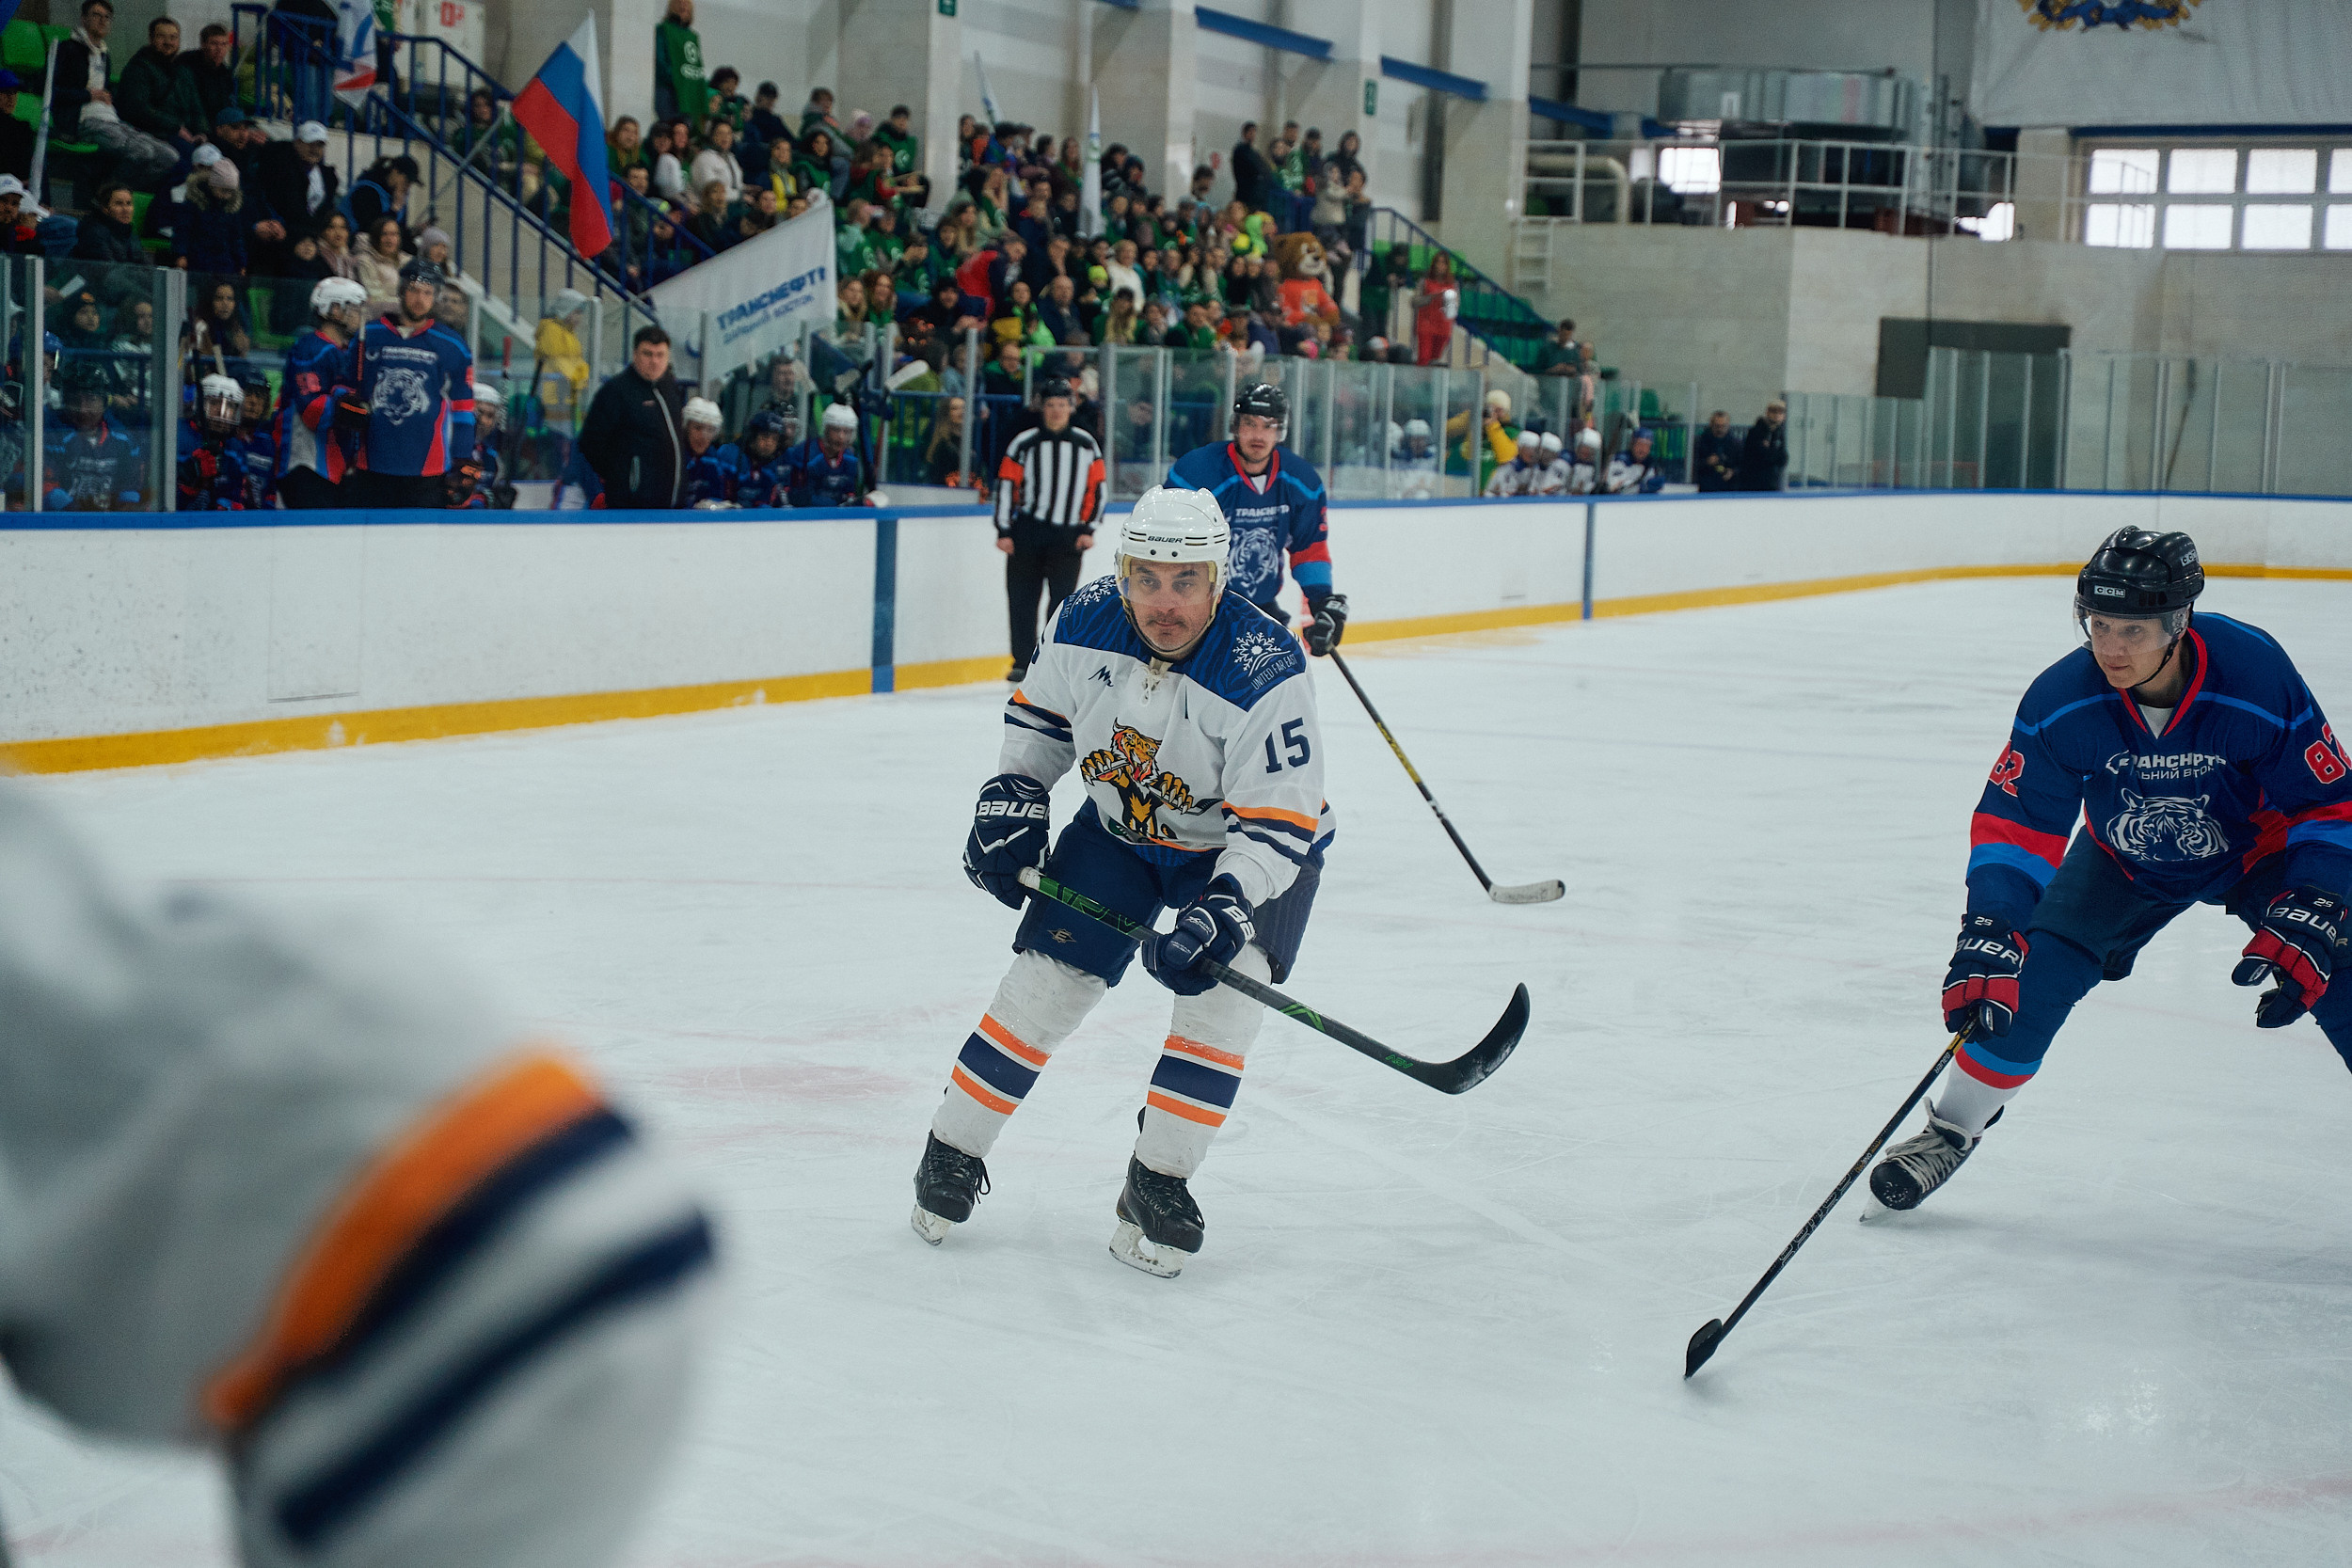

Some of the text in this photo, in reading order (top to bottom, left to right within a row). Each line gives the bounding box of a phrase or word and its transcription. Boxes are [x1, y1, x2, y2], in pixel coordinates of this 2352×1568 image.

[1148, 535, 1183, 544] BAUER
[2095, 586, 2125, 597] CCM
[1250, 653, 1298, 690] UNITED FAR EAST
[1264, 717, 1311, 773] 15
[2313, 897, 2334, 908] 25
[1974, 916, 1994, 927] 25
[2271, 907, 2348, 948] BAUER
